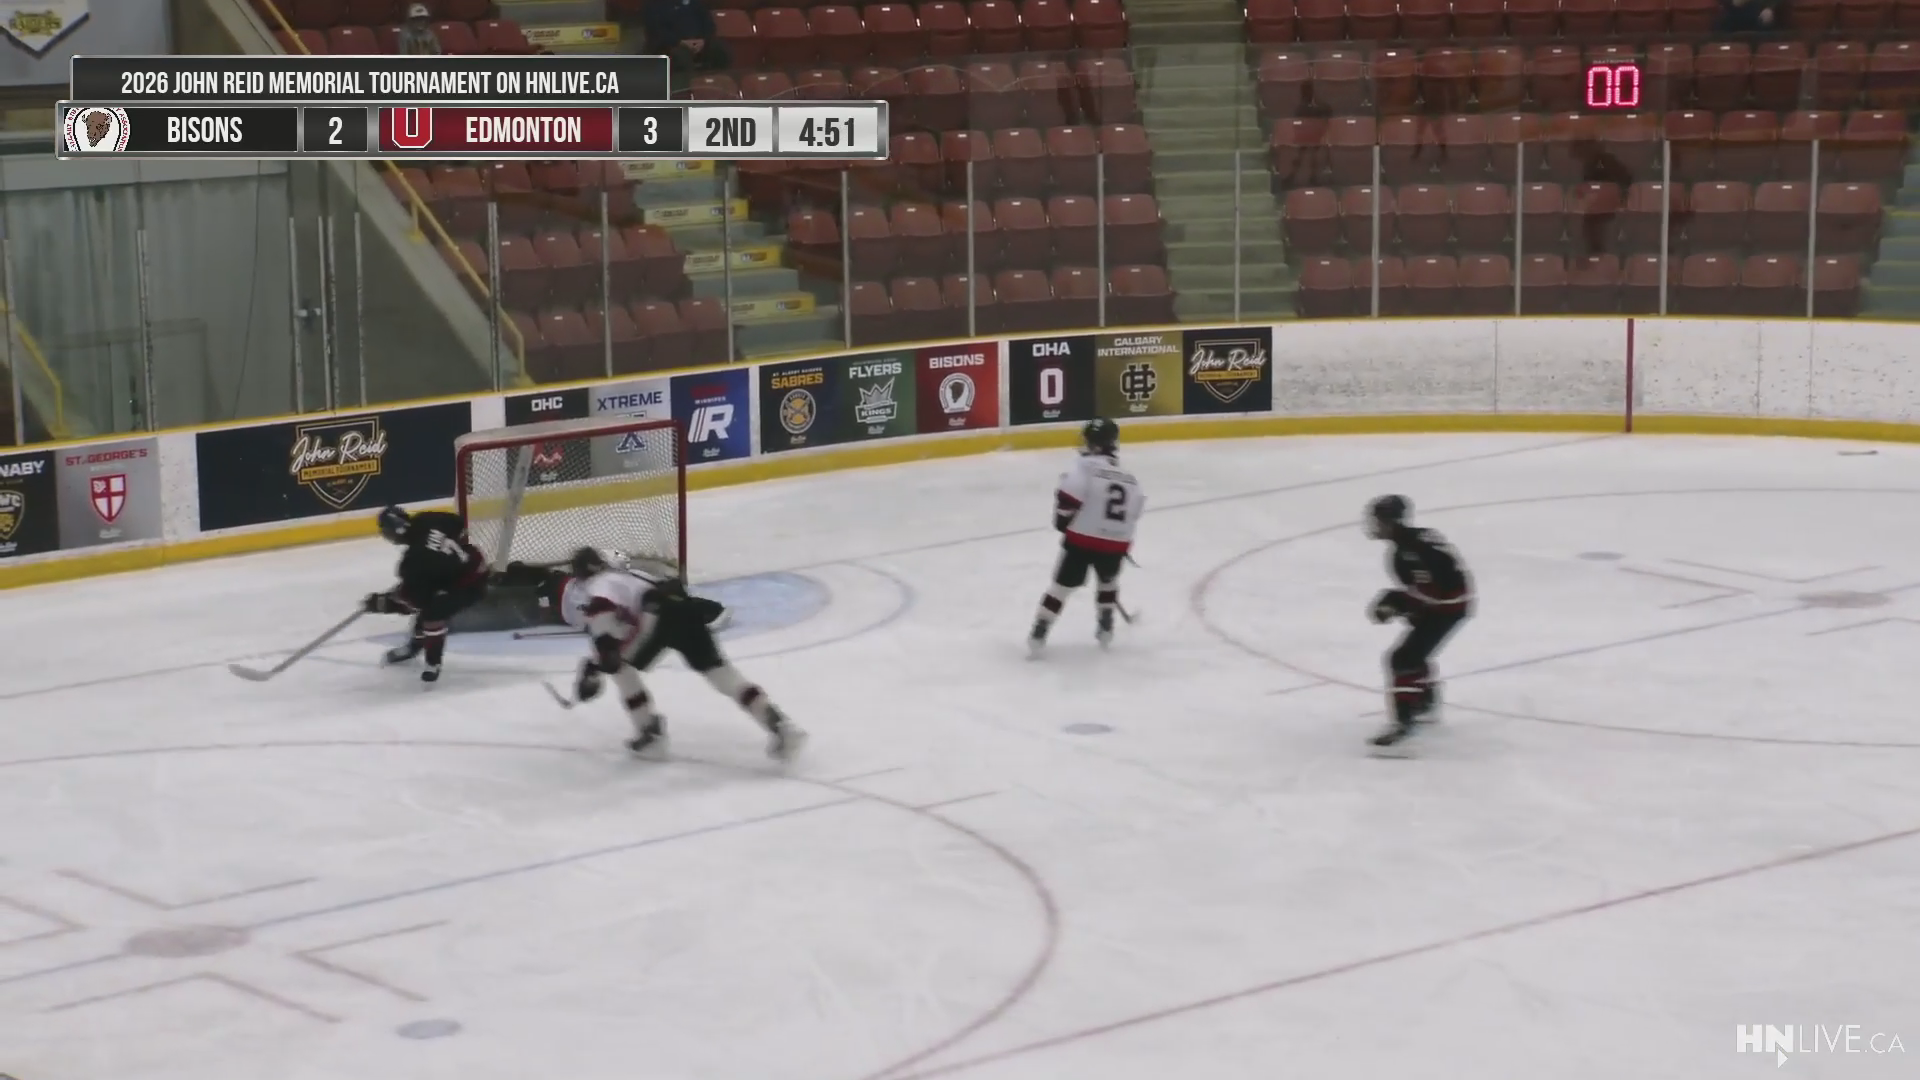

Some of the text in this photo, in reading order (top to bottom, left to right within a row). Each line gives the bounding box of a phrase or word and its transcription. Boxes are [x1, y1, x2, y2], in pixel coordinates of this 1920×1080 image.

[1587, 65, 1639, 107] 00
[1032, 341, 1071, 357] OHA
[1114, 336, 1163, 347] CALGARY
[1097, 344, 1180, 357] INTERNATIONAL
[929, 353, 985, 369] BISONS
[1188, 348, 1267, 375] John Reid
[849, 362, 902, 379] FLYERS
[771, 373, 824, 389] SABRES
[531, 396, 563, 412] OHC
[597, 391, 663, 412] XTREME
[861, 408, 892, 417] KINGS
[87, 448, 148, 464] GEORGE'S
[291, 431, 387, 474] John Reid
[1105, 483, 1127, 522] 2
